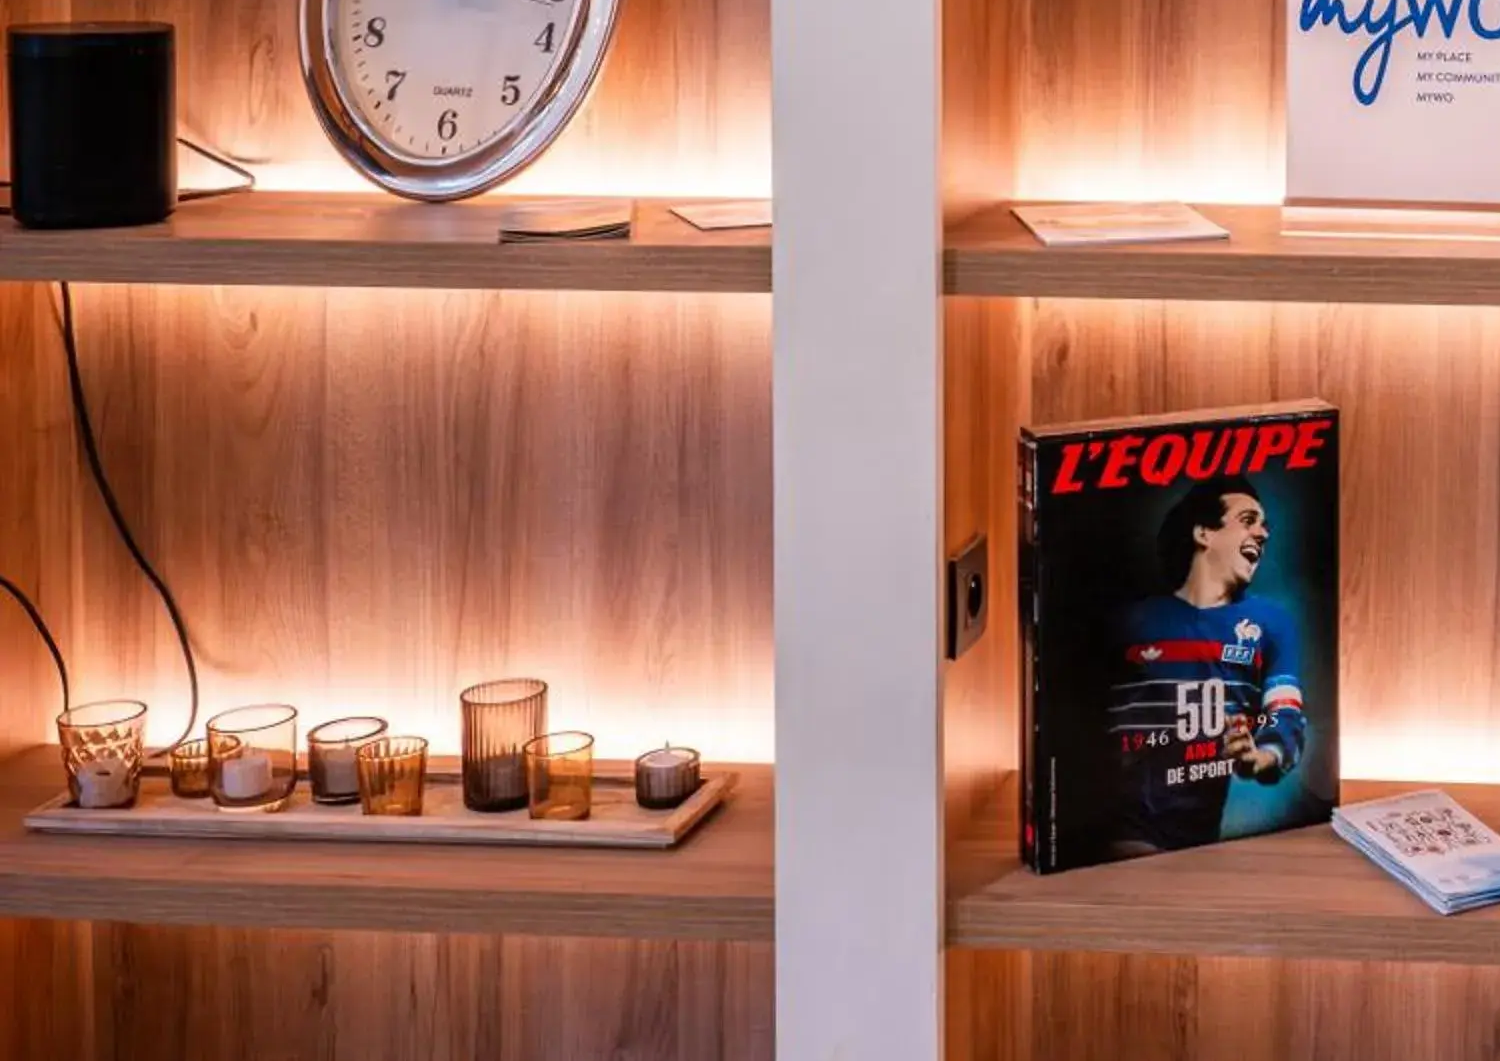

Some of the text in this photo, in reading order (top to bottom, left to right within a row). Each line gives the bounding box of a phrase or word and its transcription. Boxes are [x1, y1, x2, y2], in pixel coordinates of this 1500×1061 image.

[364, 17, 386, 47] 8
[534, 23, 555, 53] 4
[1417, 52, 1472, 63] MY PLACE
[386, 71, 406, 100] 7
[433, 86, 473, 98] QUARTZ
[501, 76, 521, 105] 5
[1417, 73, 1433, 83] MY
[1416, 93, 1453, 104] MYWO
[437, 110, 457, 139] 6
[1176, 677, 1225, 741] 50
[1120, 730, 1170, 754] 1946
[1185, 741, 1218, 762] ANS
[1167, 758, 1236, 786] DE SPORT
